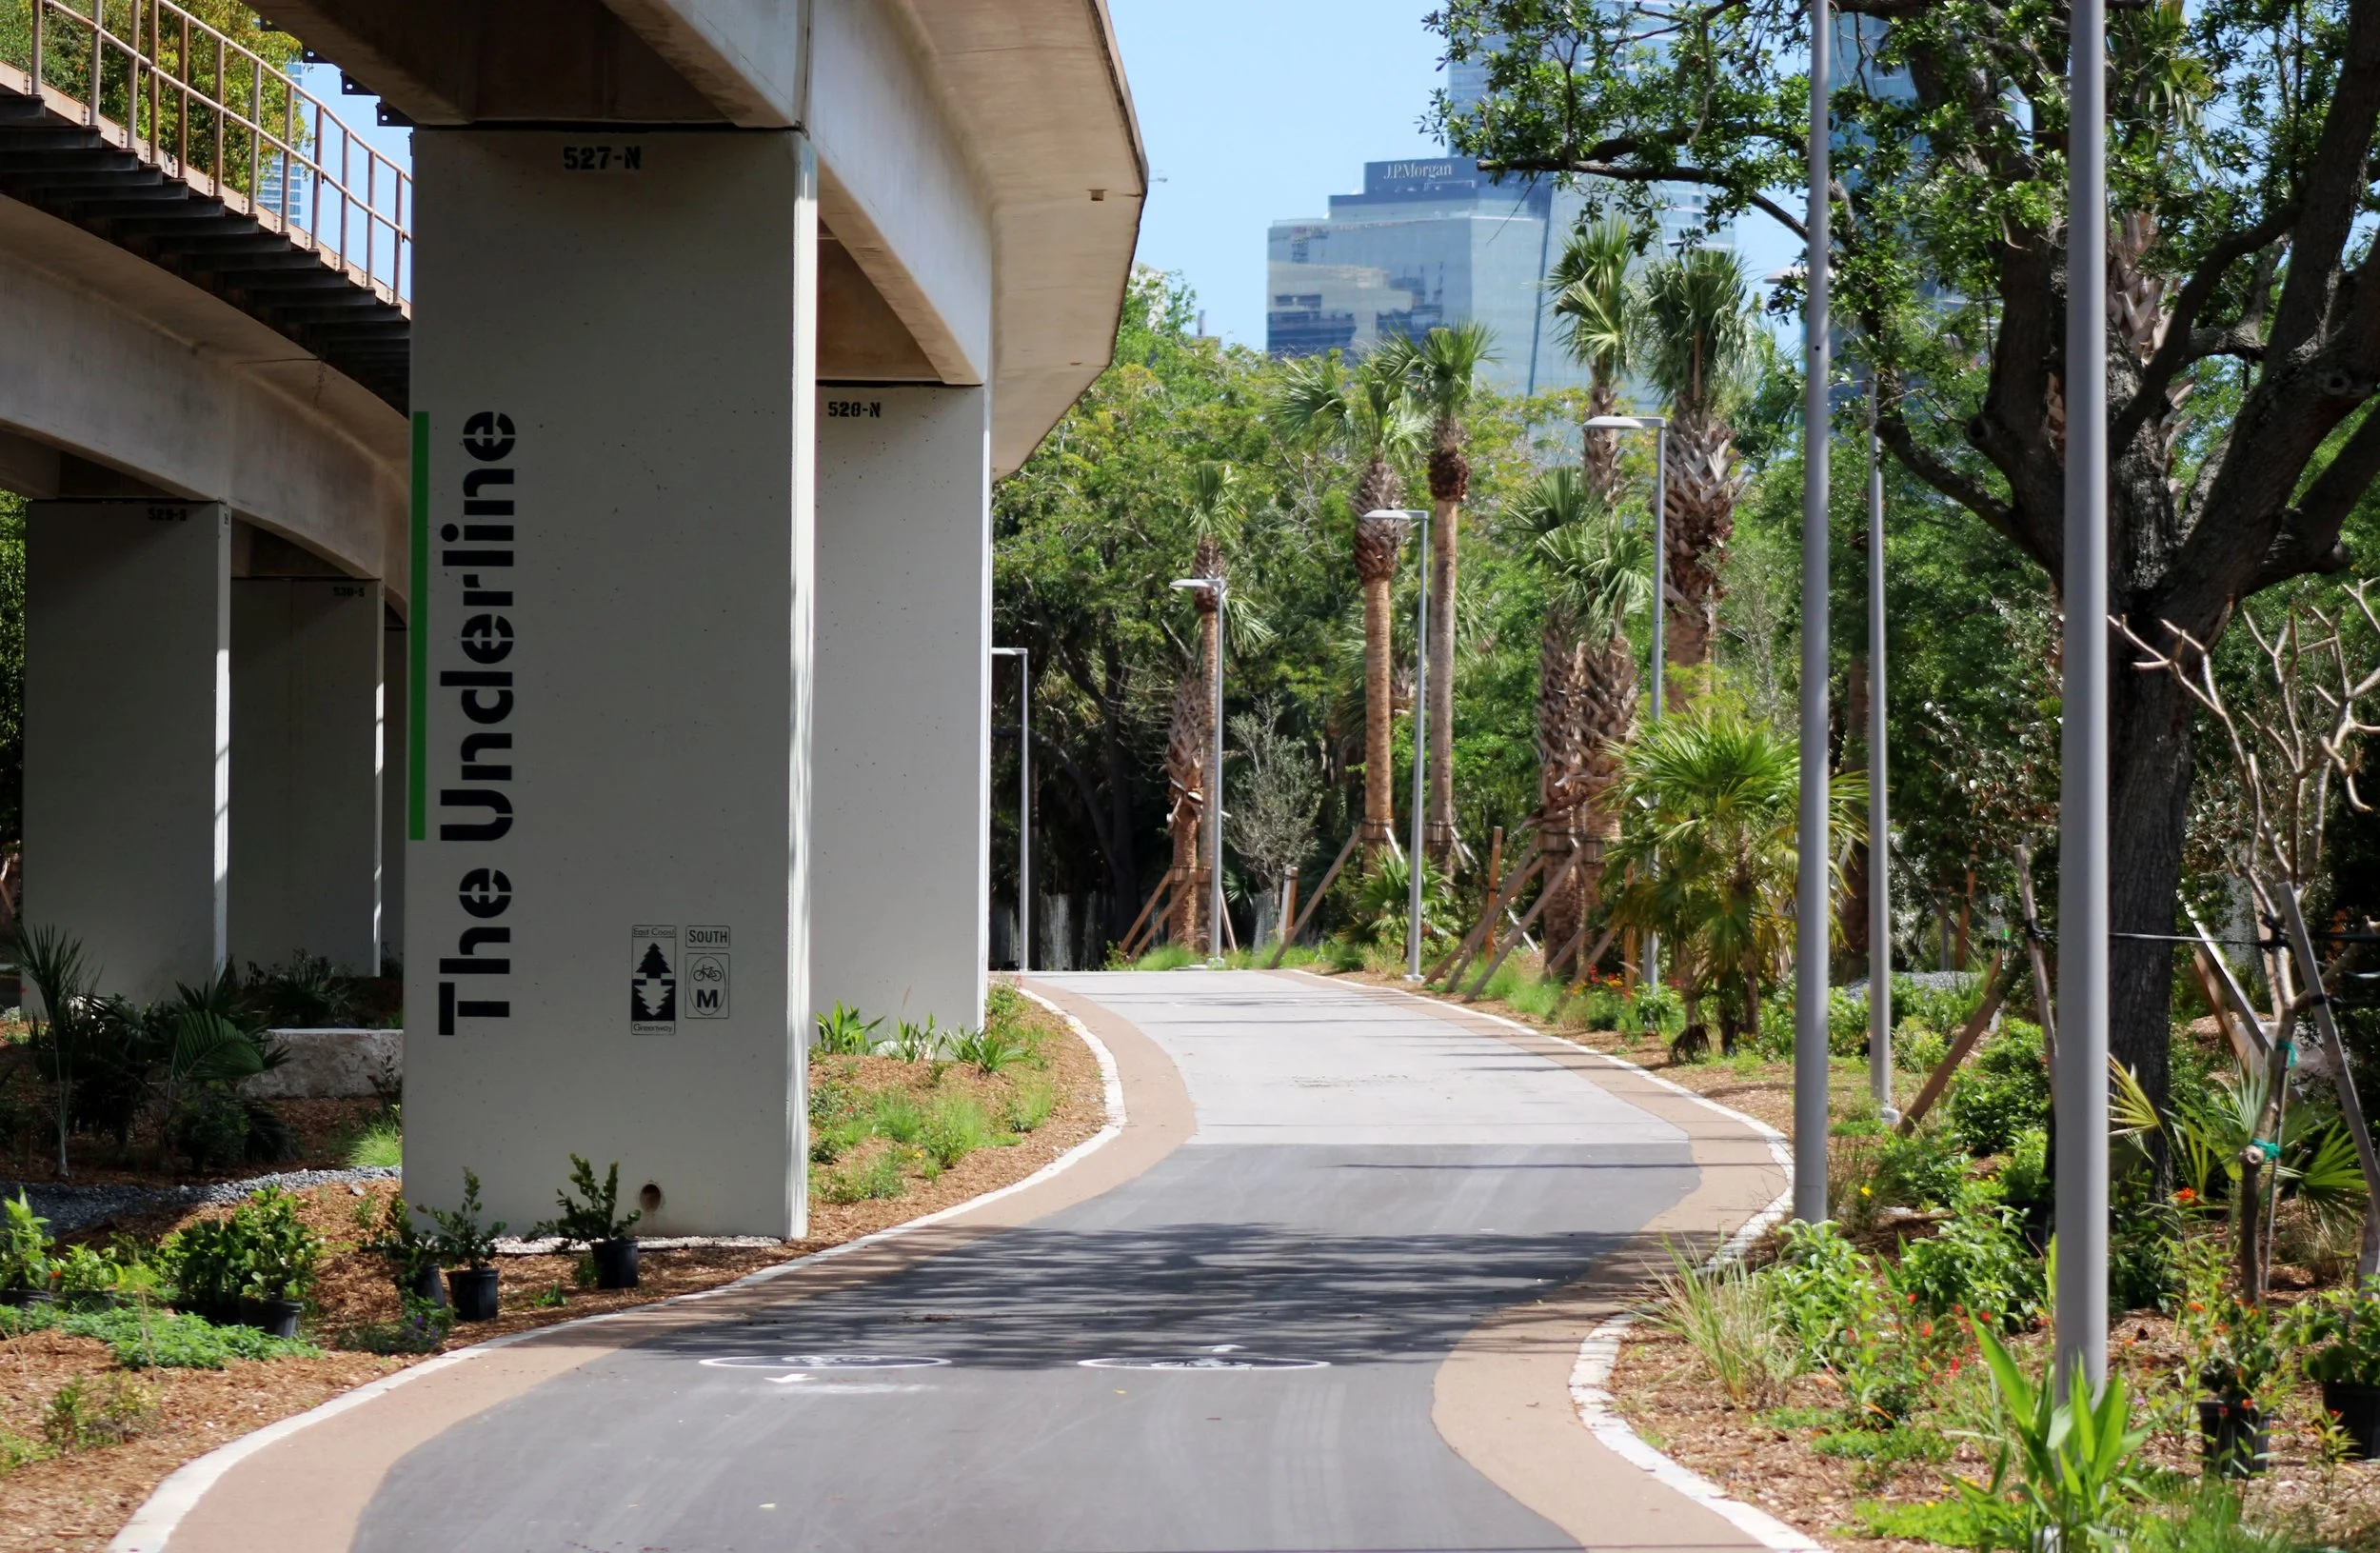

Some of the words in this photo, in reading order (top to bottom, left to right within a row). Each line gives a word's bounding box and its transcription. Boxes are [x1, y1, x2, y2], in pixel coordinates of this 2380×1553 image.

[564, 146, 641, 169] 527-N
[440, 410, 516, 841] Underline
[688, 929, 728, 944] SOUTH
[438, 866, 512, 1036] The
[696, 988, 718, 1008] M
[633, 1023, 672, 1033] Greenway
